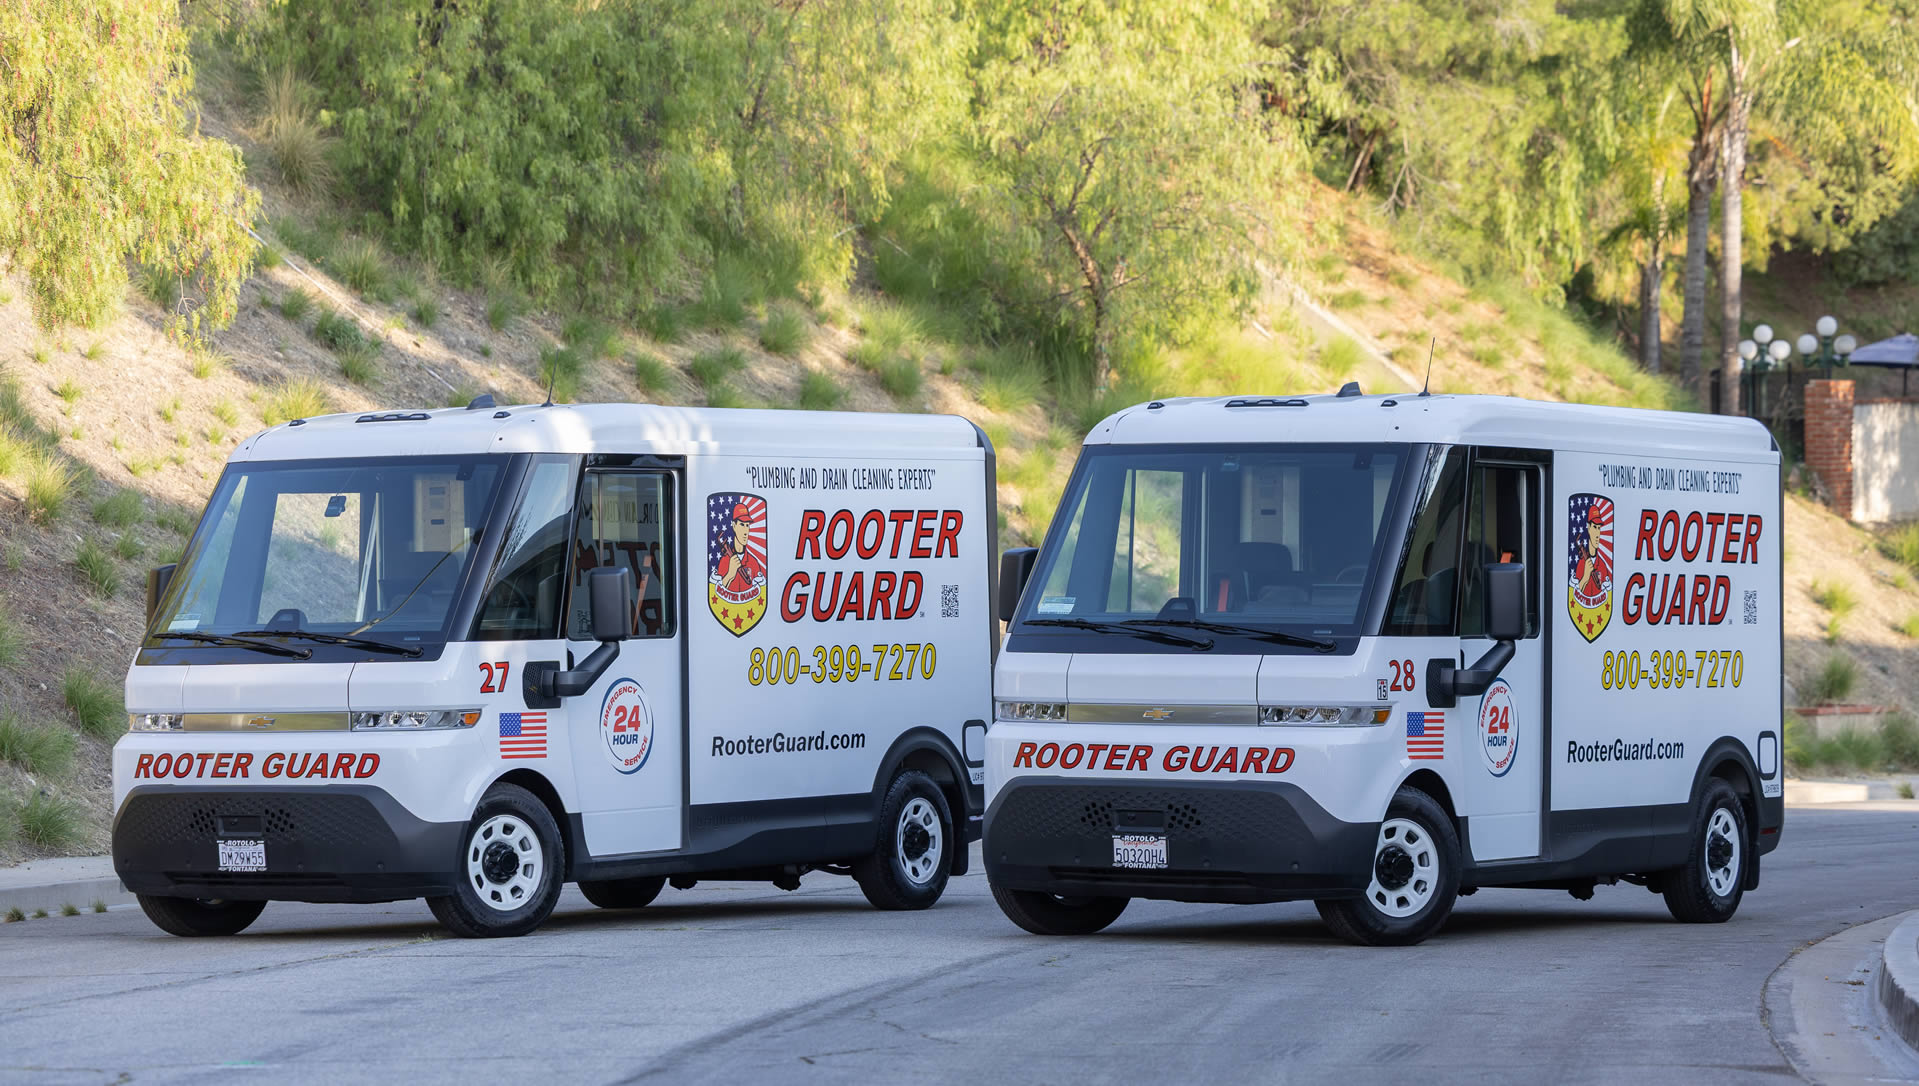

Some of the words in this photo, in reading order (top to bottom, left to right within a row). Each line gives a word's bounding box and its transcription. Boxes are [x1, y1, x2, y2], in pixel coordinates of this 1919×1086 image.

[799, 468, 818, 489] AND
[822, 468, 848, 490] DRAIN
[853, 468, 894, 491] CLEANING
[1638, 467, 1652, 489] AND
[1656, 467, 1675, 491] DRAIN
[1678, 469, 1710, 493] CLEANING
[795, 509, 964, 560] ROOTER
[1635, 509, 1763, 565] ROOTER
[779, 571, 925, 624] GUARD
[1621, 572, 1732, 626] GUARD
[479, 661, 510, 694] 27
[748, 642, 937, 687] 800-399-7270
[1389, 659, 1415, 691] 28
[1601, 650, 1744, 690] 800-399-7270
[603, 686, 638, 728] EMERGENCY
[613, 705, 640, 733] 24
[1481, 686, 1508, 728] EMERGENCY
[1488, 706, 1509, 734] 24
[612, 734, 639, 746] HOUR
[624, 735, 649, 766] SERVICE
[712, 731, 866, 757] RooterGuard.com
[1487, 735, 1508, 747] HOUR
[1495, 737, 1514, 769] SERVICE
[1568, 737, 1684, 764] RooterGuard.com
[134, 753, 254, 779] ROOTER
[261, 752, 381, 779] GUARD
[1013, 742, 1154, 773] ROOTER
[1162, 745, 1296, 774] GUARD
[221, 851, 264, 866] DM29W55
[1115, 848, 1165, 863] 50320H4
